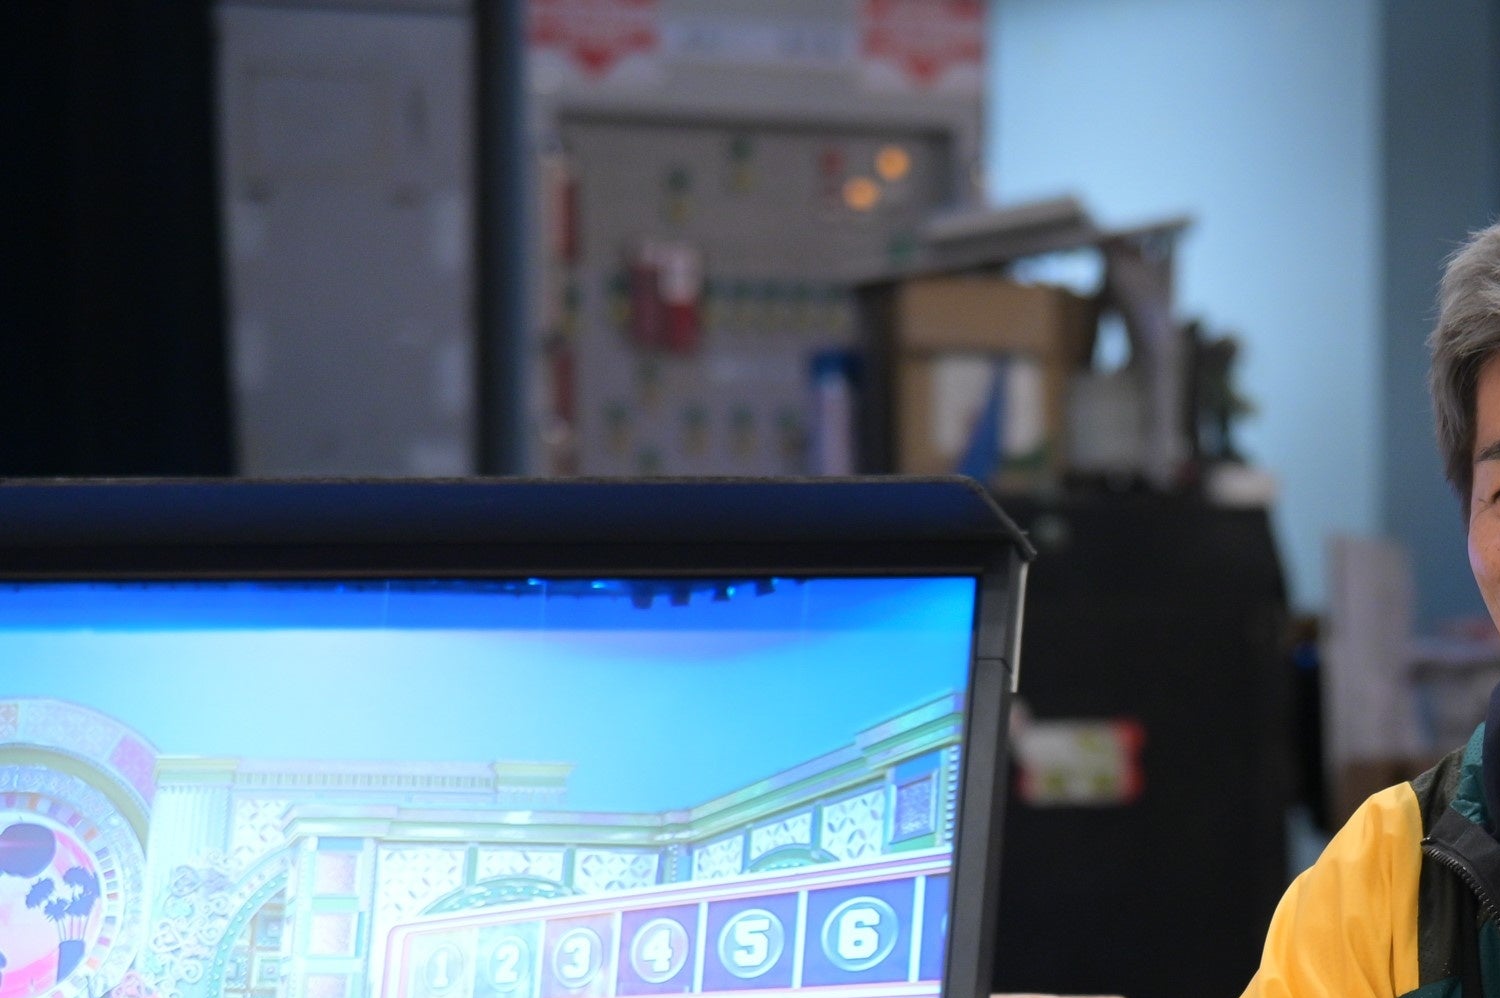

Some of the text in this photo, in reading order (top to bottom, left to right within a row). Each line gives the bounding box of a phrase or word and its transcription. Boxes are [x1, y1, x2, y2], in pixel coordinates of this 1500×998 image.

[432, 908, 880, 988] 1 2 3 4 5 6
